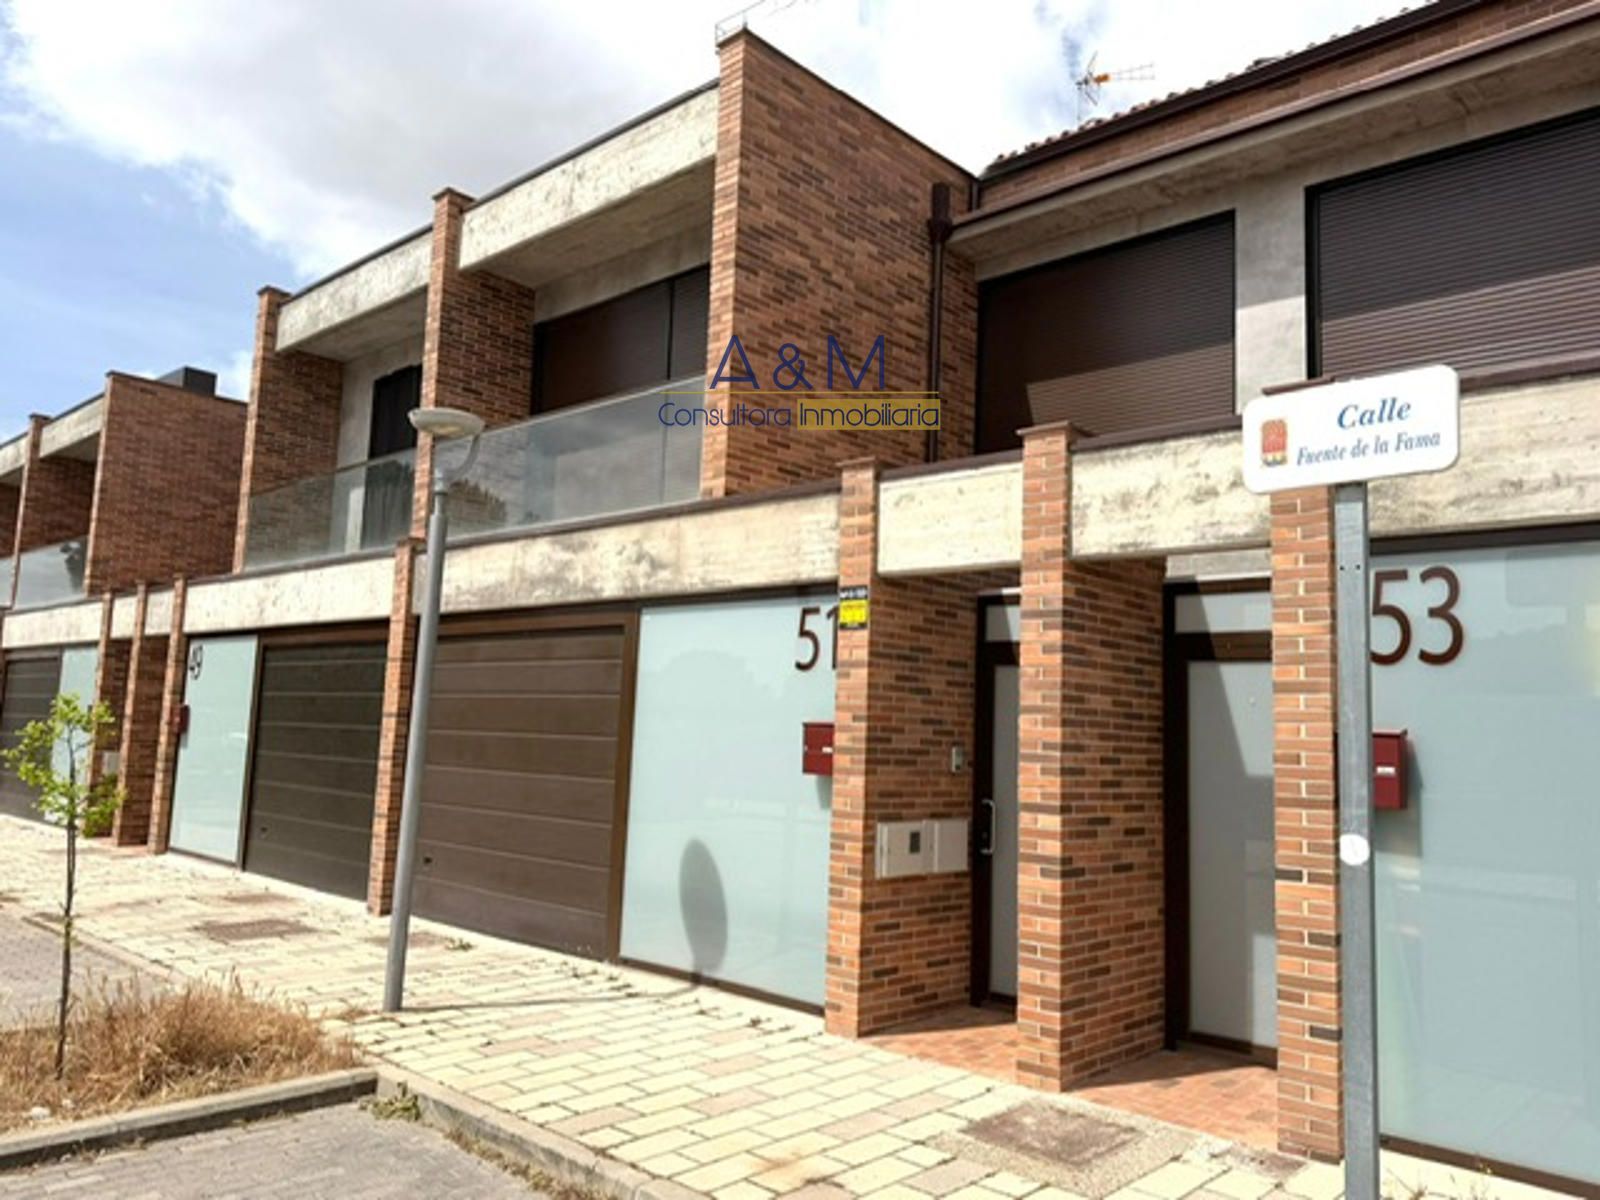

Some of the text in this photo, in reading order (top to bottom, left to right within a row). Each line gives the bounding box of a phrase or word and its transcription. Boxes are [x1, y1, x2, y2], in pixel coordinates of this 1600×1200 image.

[1337, 397, 1411, 430] Calle
[1297, 430, 1441, 466] Fuente de la Fama
[795, 605, 838, 672] 51
[1370, 566, 1464, 665] 53
